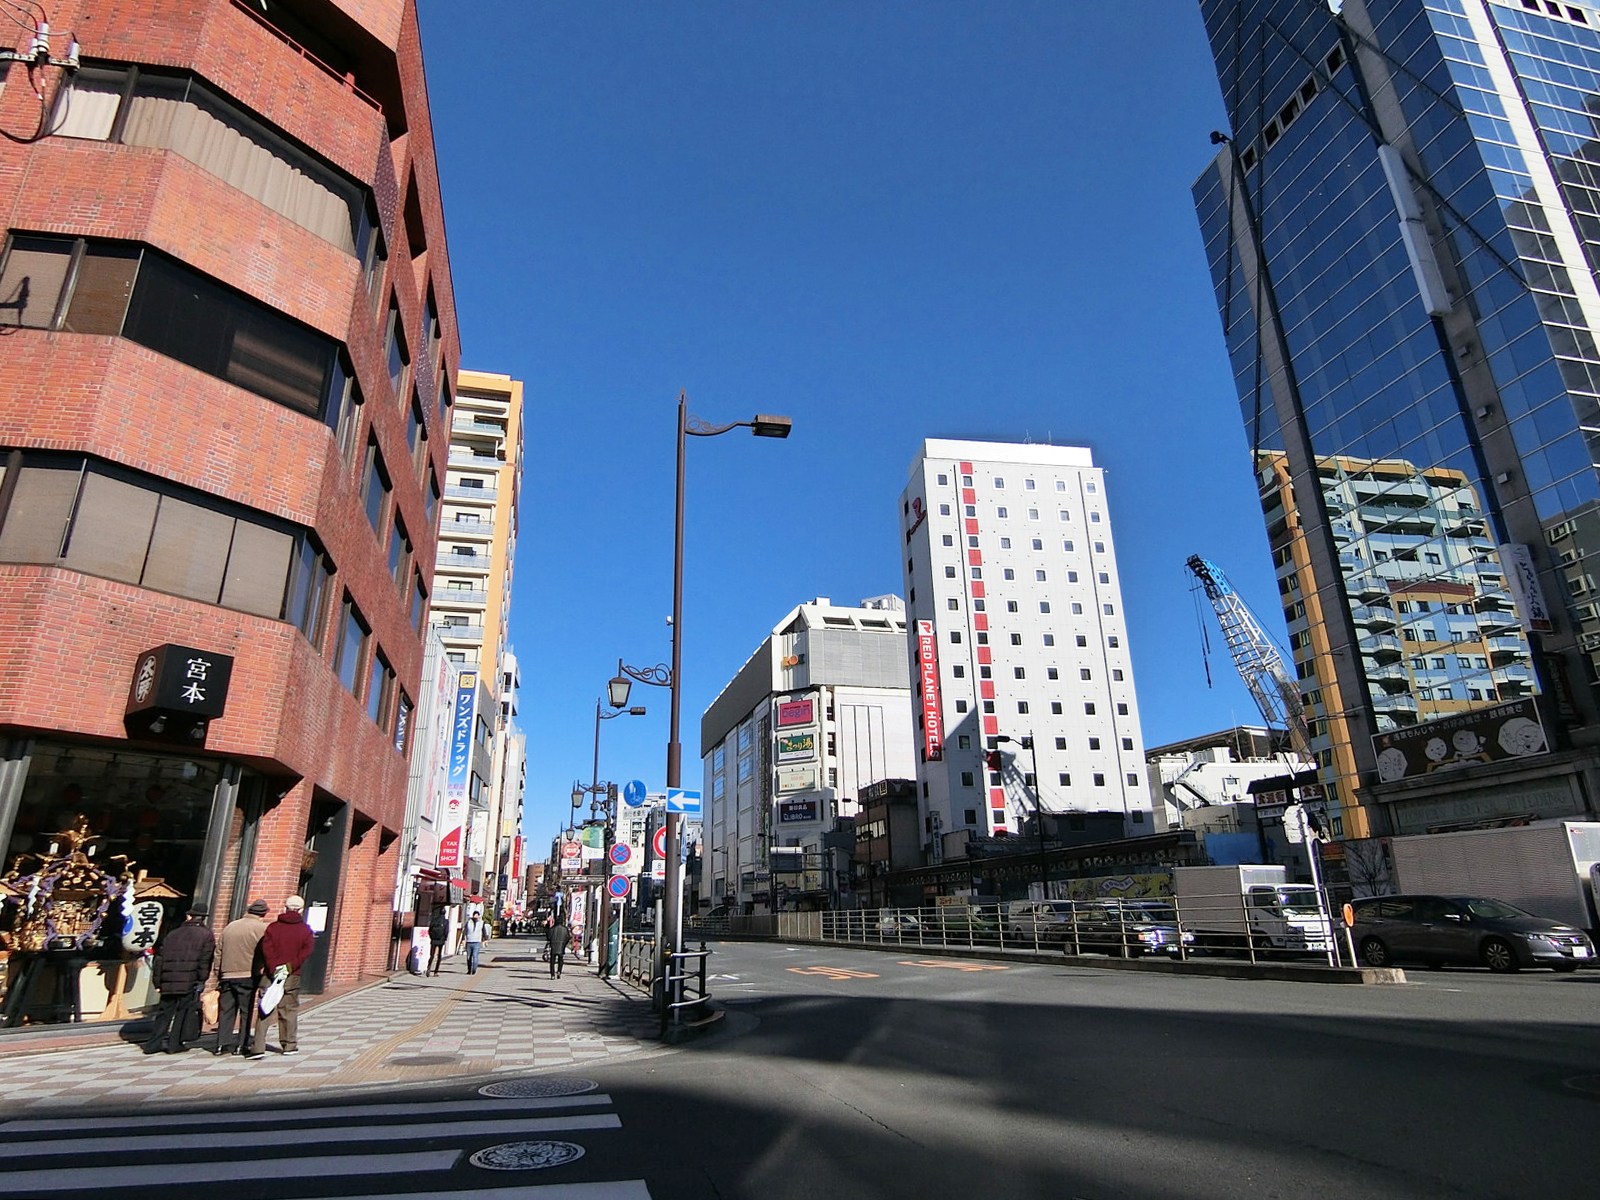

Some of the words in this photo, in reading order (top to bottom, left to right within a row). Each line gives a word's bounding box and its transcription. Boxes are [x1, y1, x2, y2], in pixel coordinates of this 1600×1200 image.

[922, 636, 932, 660] RED
[180, 657, 212, 704] 宮本
[923, 663, 936, 708] PLANET
[452, 694, 471, 777] ワンズドラッグ
[781, 707, 811, 719] begin
[927, 711, 939, 758] HOTELS
[131, 903, 161, 948] 宮本
